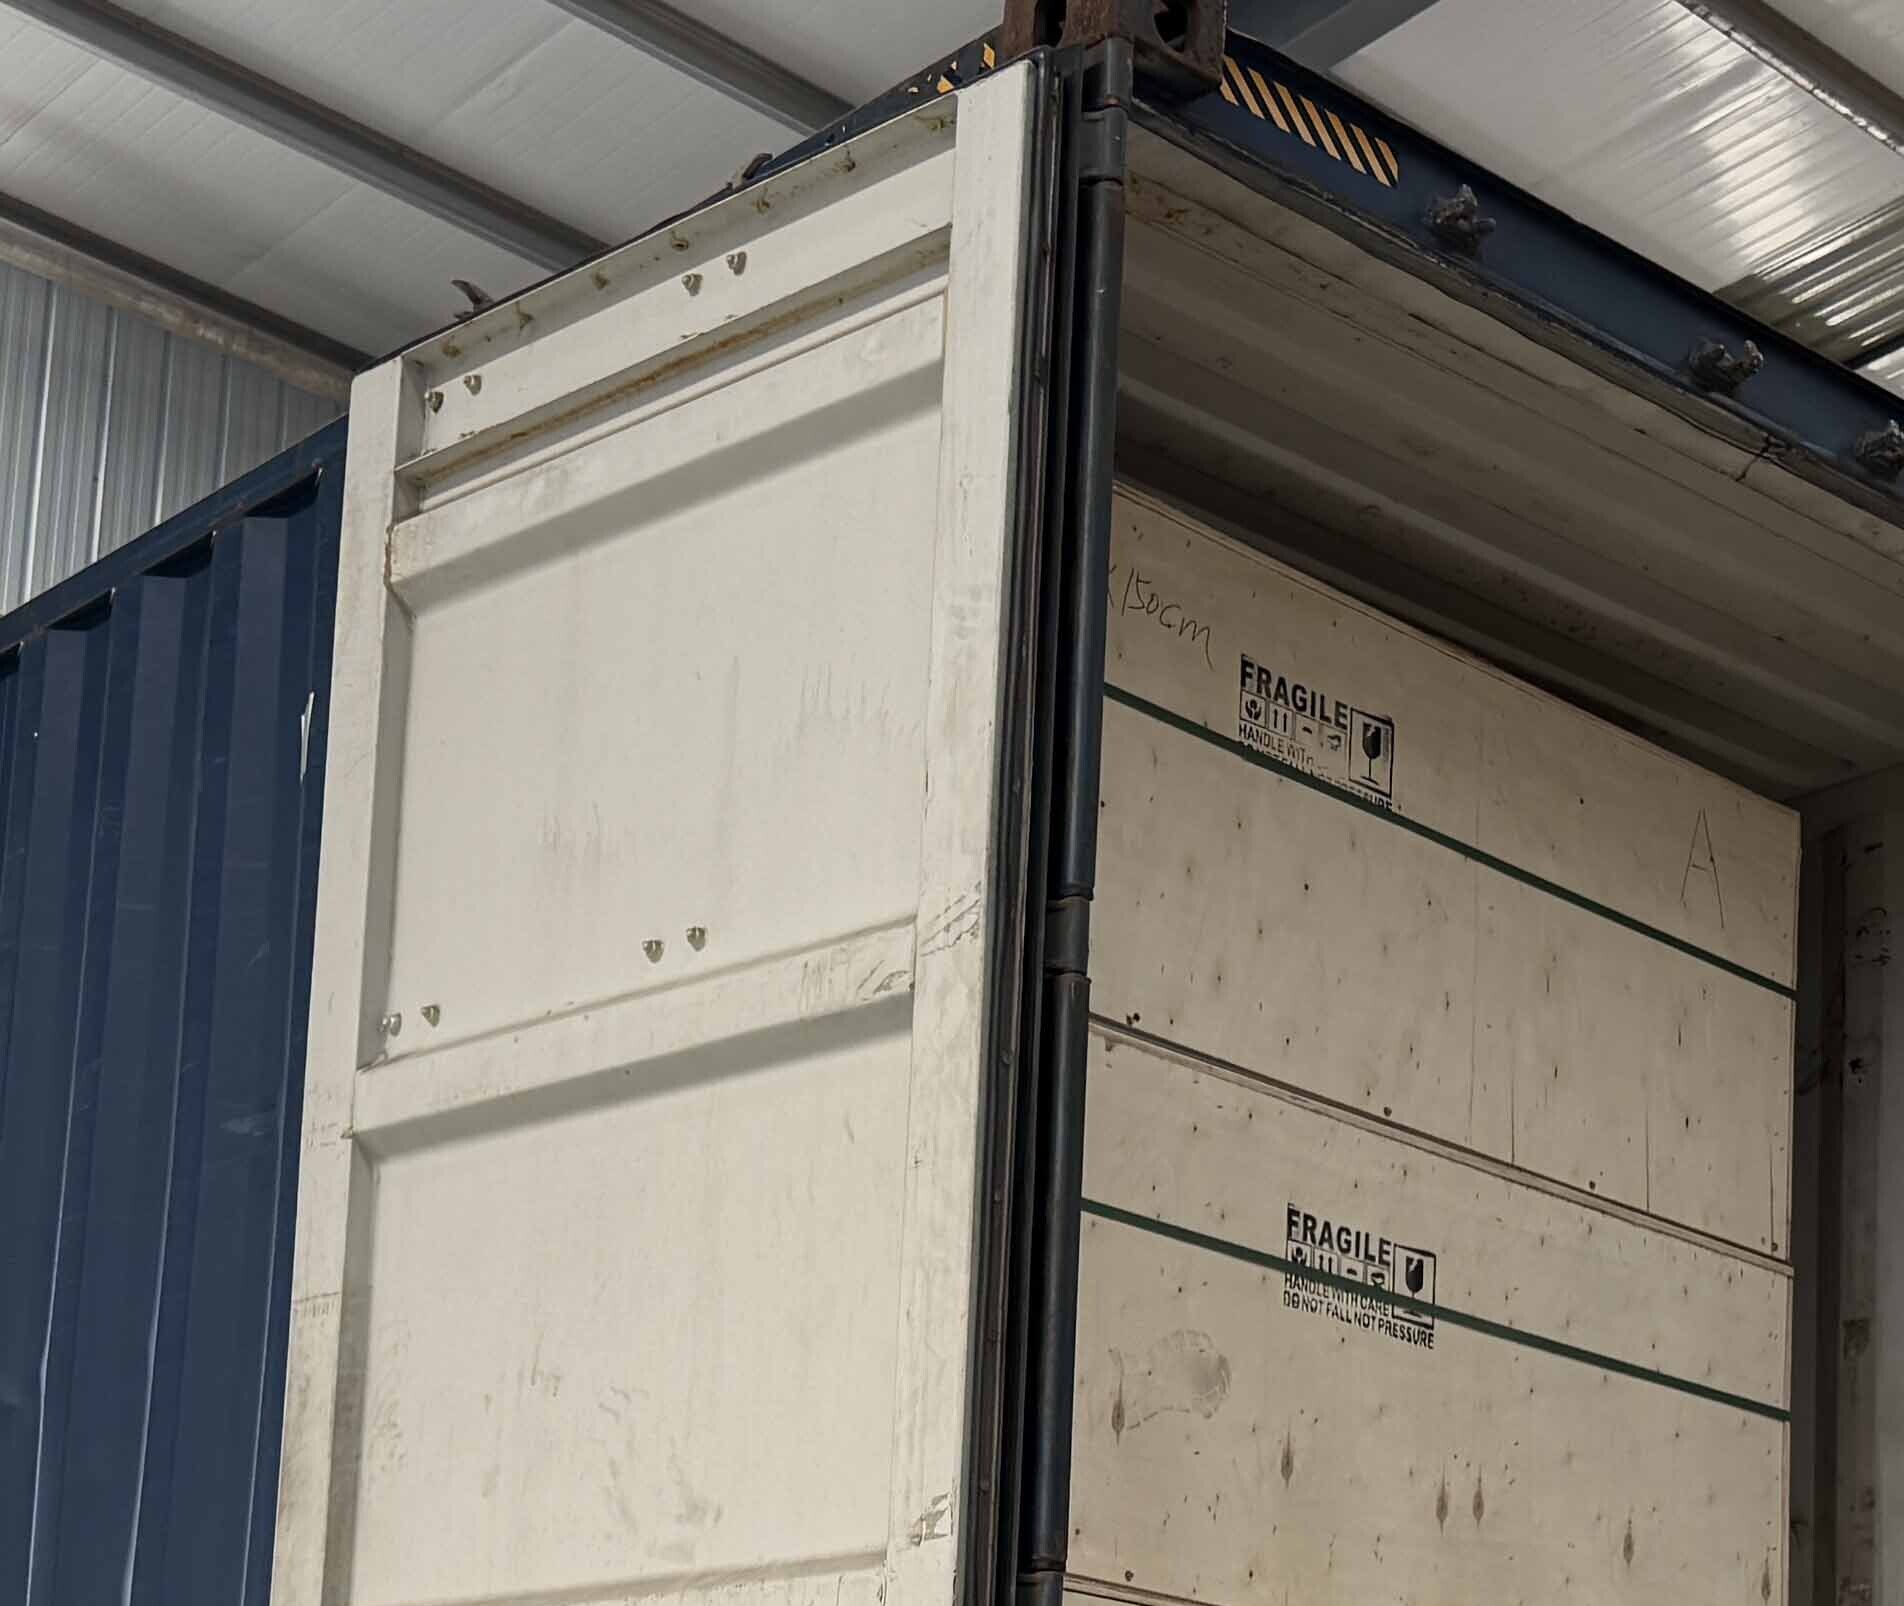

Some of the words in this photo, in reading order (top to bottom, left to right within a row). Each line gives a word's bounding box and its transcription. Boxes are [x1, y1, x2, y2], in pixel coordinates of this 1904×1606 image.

[1240, 657, 1348, 731] FRAGILE
[1238, 722, 1284, 754] HANDLE
[1680, 808, 1725, 929] A
[1287, 1207, 1392, 1268] FRAGILE
[1283, 1290, 1299, 1310] DO
[1301, 1296, 1324, 1314] NOT
[1326, 1302, 1352, 1324] FALL
[1354, 1311, 1377, 1331] NOT
[1378, 1317, 1435, 1350] PRESSURE
[1284, 1273, 1330, 1299] HANDLE
[1360, 1297, 1390, 1317] CARE
